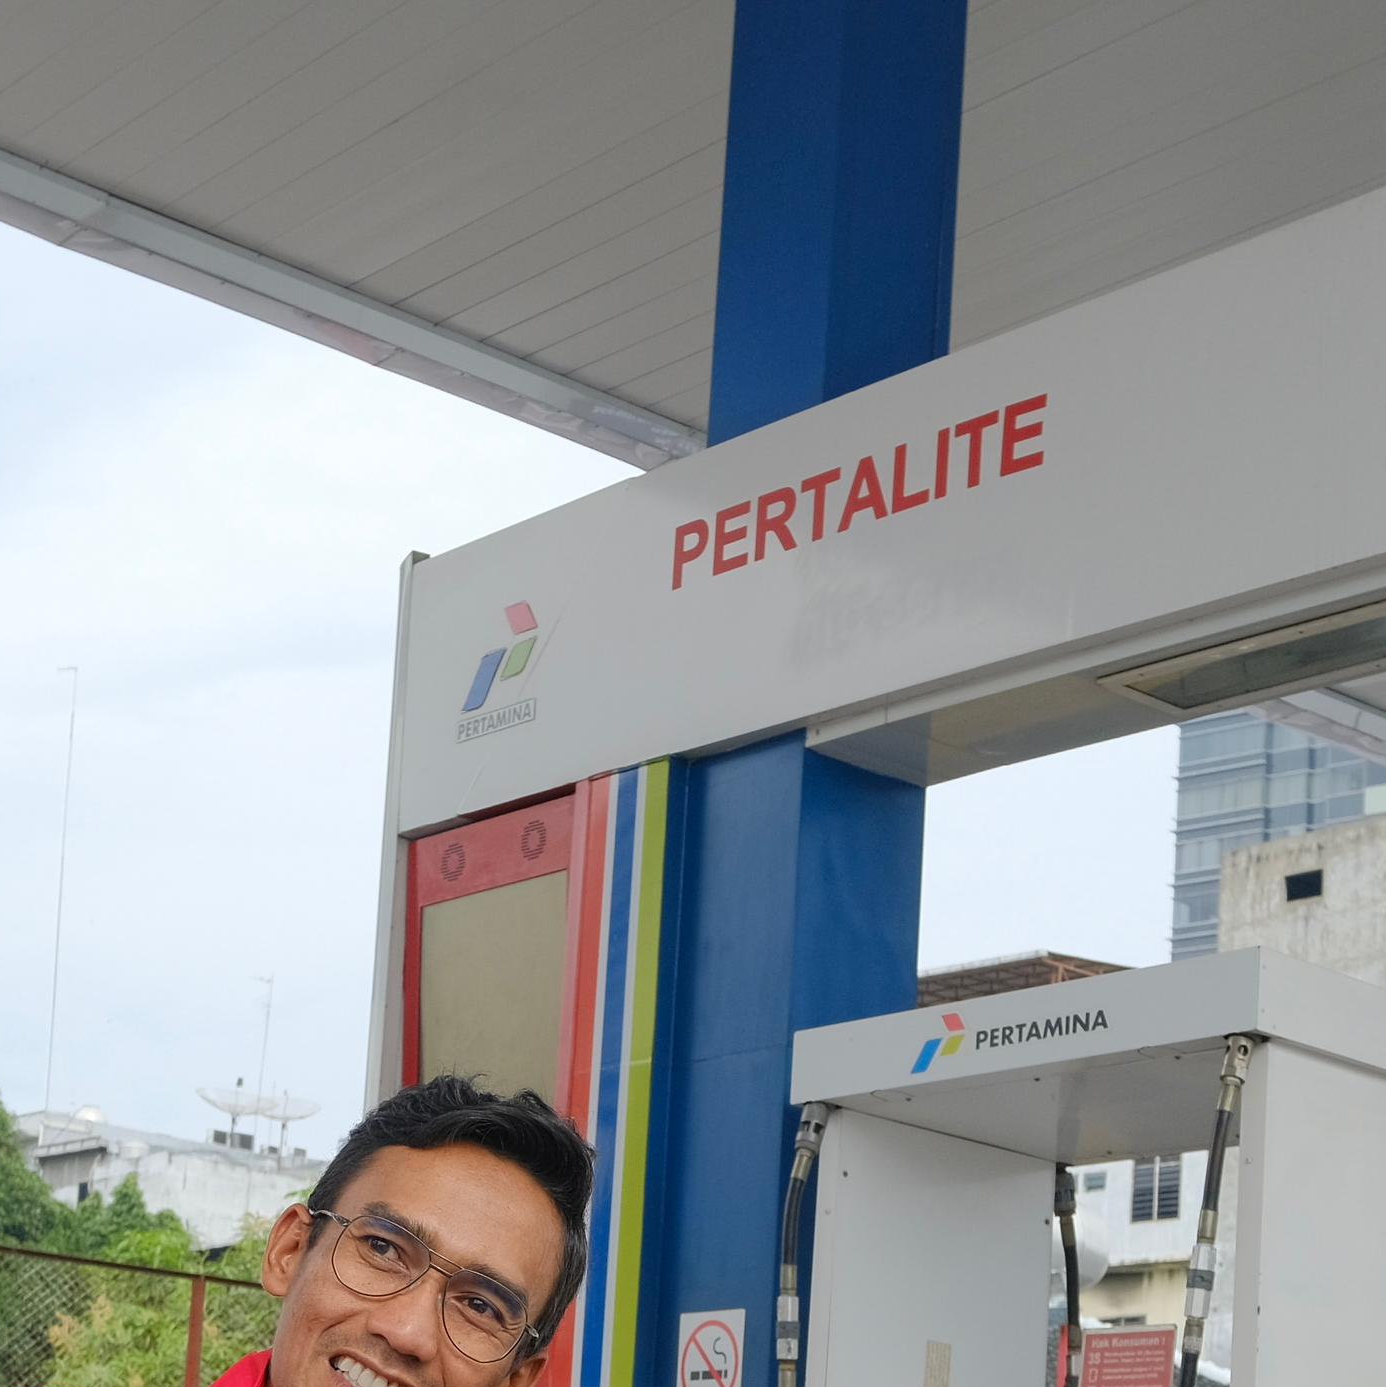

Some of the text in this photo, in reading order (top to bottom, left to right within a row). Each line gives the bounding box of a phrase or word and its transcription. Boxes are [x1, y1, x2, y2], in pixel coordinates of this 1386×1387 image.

[672, 393, 1047, 590] PERTALITE
[457, 703, 531, 740] PERTAMINA
[975, 1008, 1109, 1050] PERTAMINA
